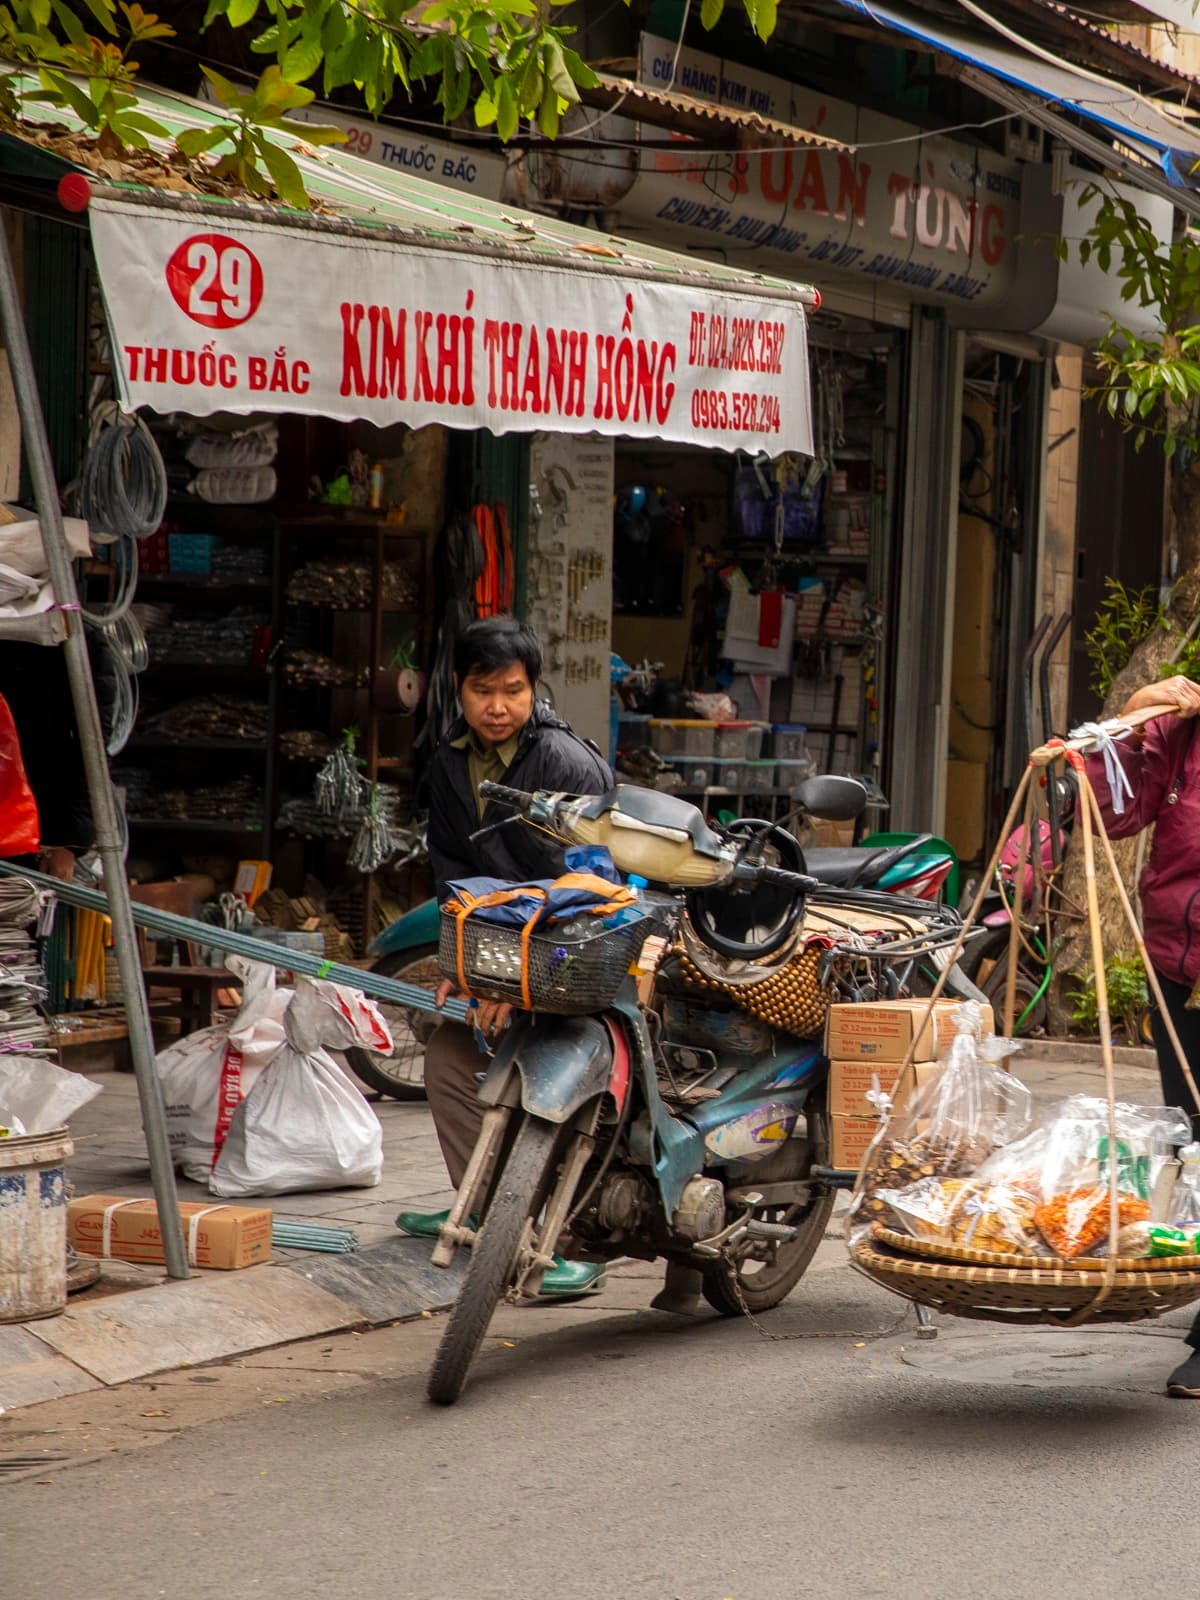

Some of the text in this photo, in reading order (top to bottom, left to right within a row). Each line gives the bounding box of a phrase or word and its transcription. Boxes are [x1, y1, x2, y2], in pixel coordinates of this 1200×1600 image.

[721, 79, 747, 105] KIM
[342, 127, 478, 183] 29 THUỐC BẮC
[886, 160, 1006, 267] TÙNG
[186, 242, 252, 323] 29
[124, 341, 311, 395] THUỐC BẮC
[339, 289, 676, 425] KIM KHÍ THANH HỒNG
[707, 313, 785, 374] 024.3828.2582
[691, 389, 781, 434] 0983.528.294
[138, 1227, 161, 1240] J42
